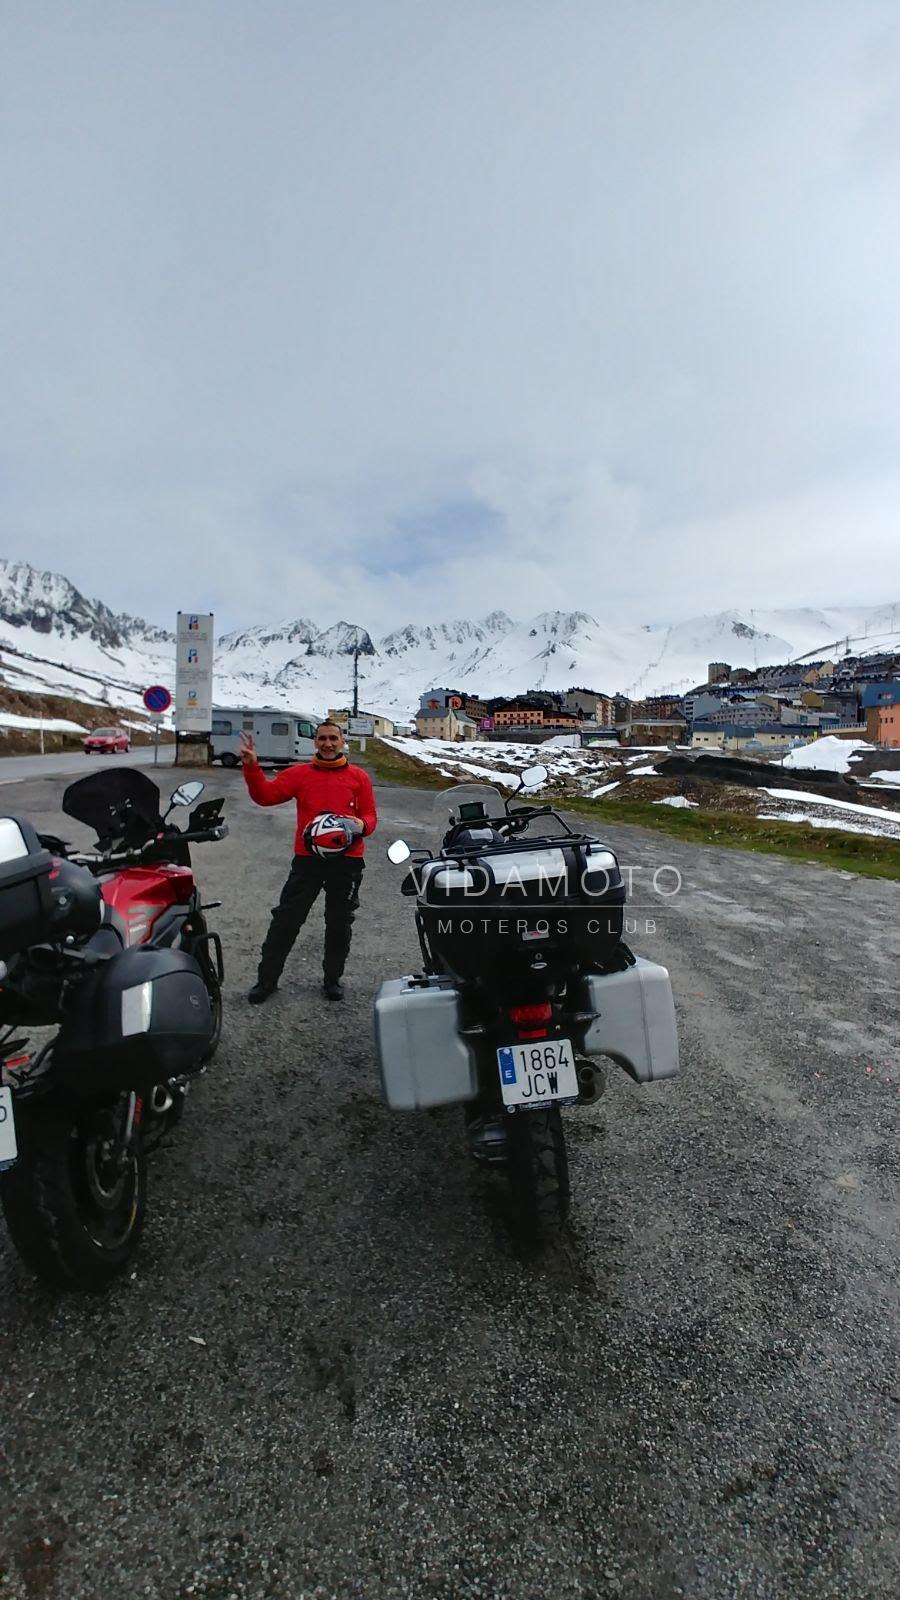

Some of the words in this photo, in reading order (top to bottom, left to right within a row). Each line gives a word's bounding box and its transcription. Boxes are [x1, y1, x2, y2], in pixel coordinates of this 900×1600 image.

[519, 1045, 569, 1073] 1864
[505, 1069, 513, 1079] E
[521, 1071, 559, 1098] JCW
